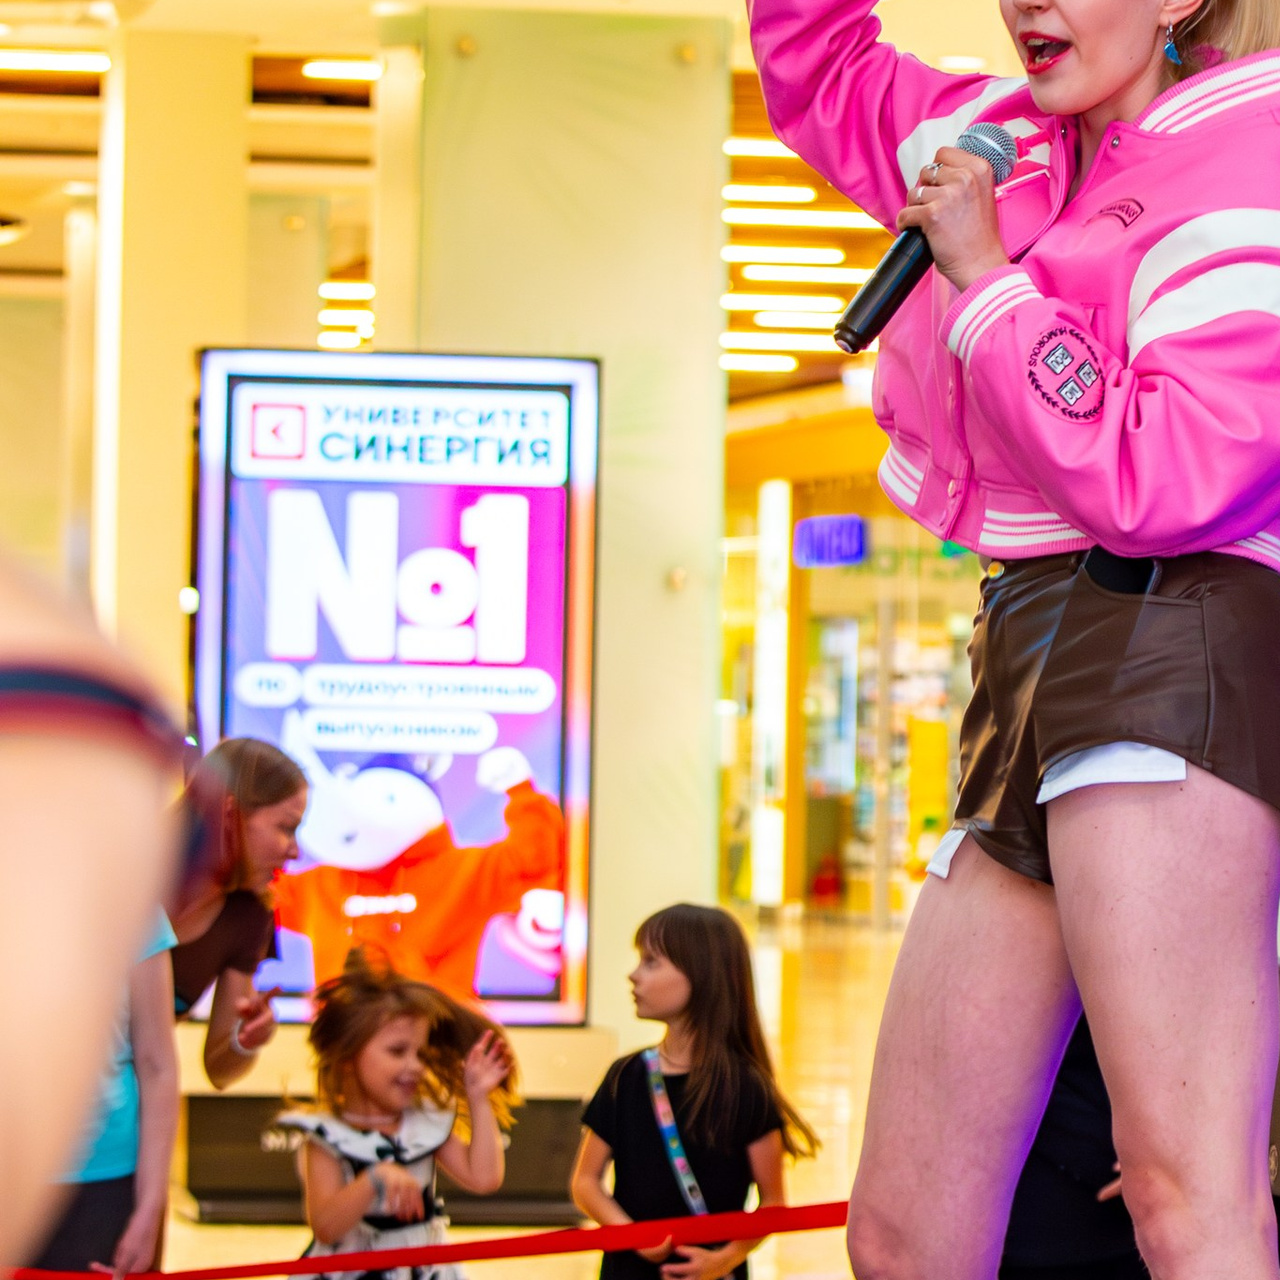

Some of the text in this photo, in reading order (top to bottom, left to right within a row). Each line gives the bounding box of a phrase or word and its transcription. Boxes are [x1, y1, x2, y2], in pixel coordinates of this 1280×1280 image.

[1028, 326, 1068, 368] HUMOROUS
[321, 403, 553, 428] УНИВЕРСИТЕТ
[319, 432, 552, 466] СИНЕРГИЯ
